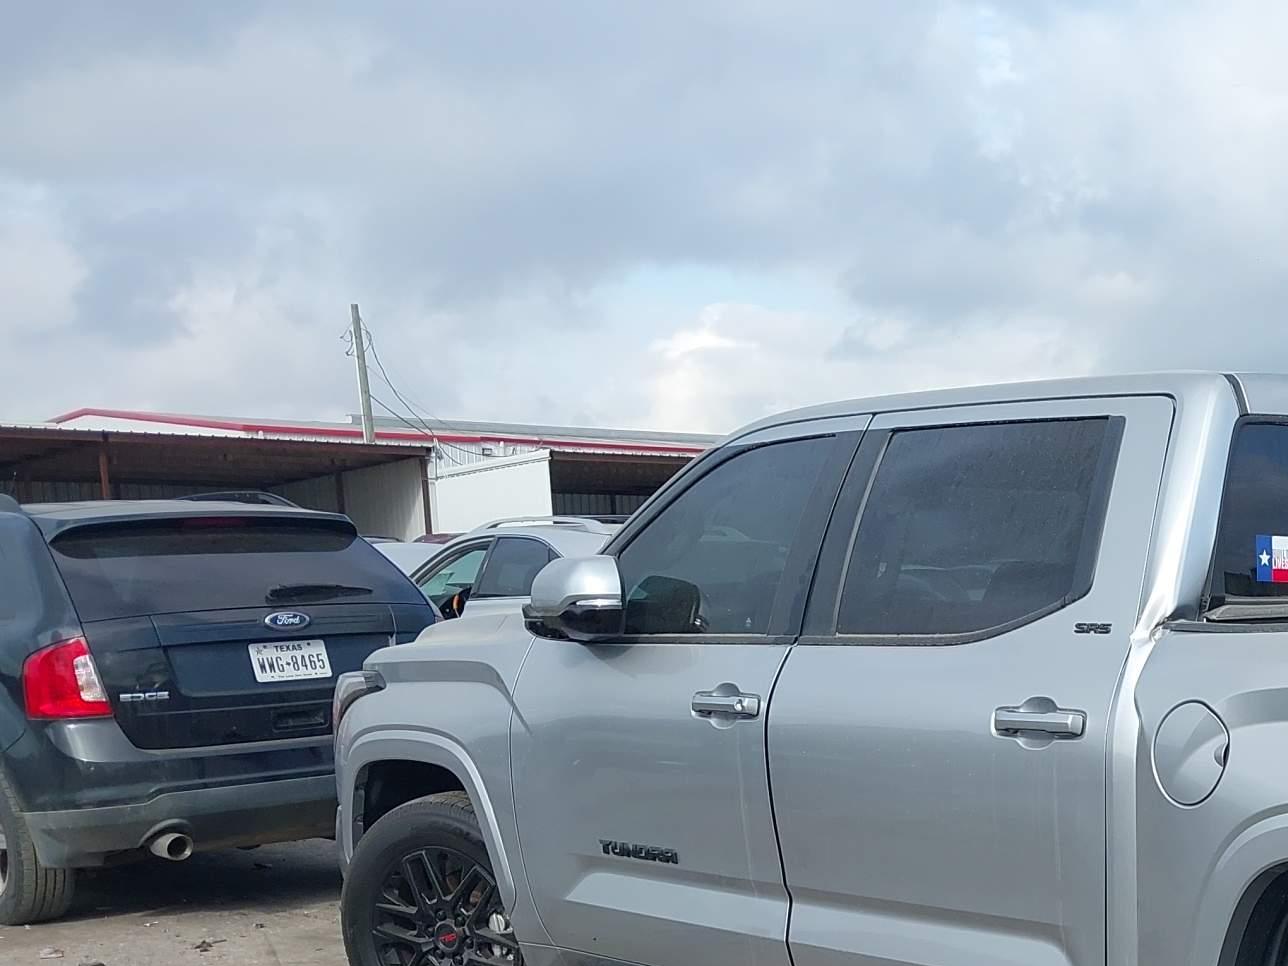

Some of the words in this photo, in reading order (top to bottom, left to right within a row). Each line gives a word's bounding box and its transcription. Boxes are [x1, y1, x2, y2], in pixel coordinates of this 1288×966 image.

[276, 614, 300, 625] Ford
[274, 644, 303, 652] TEXAS
[119, 691, 169, 701] EDGE
